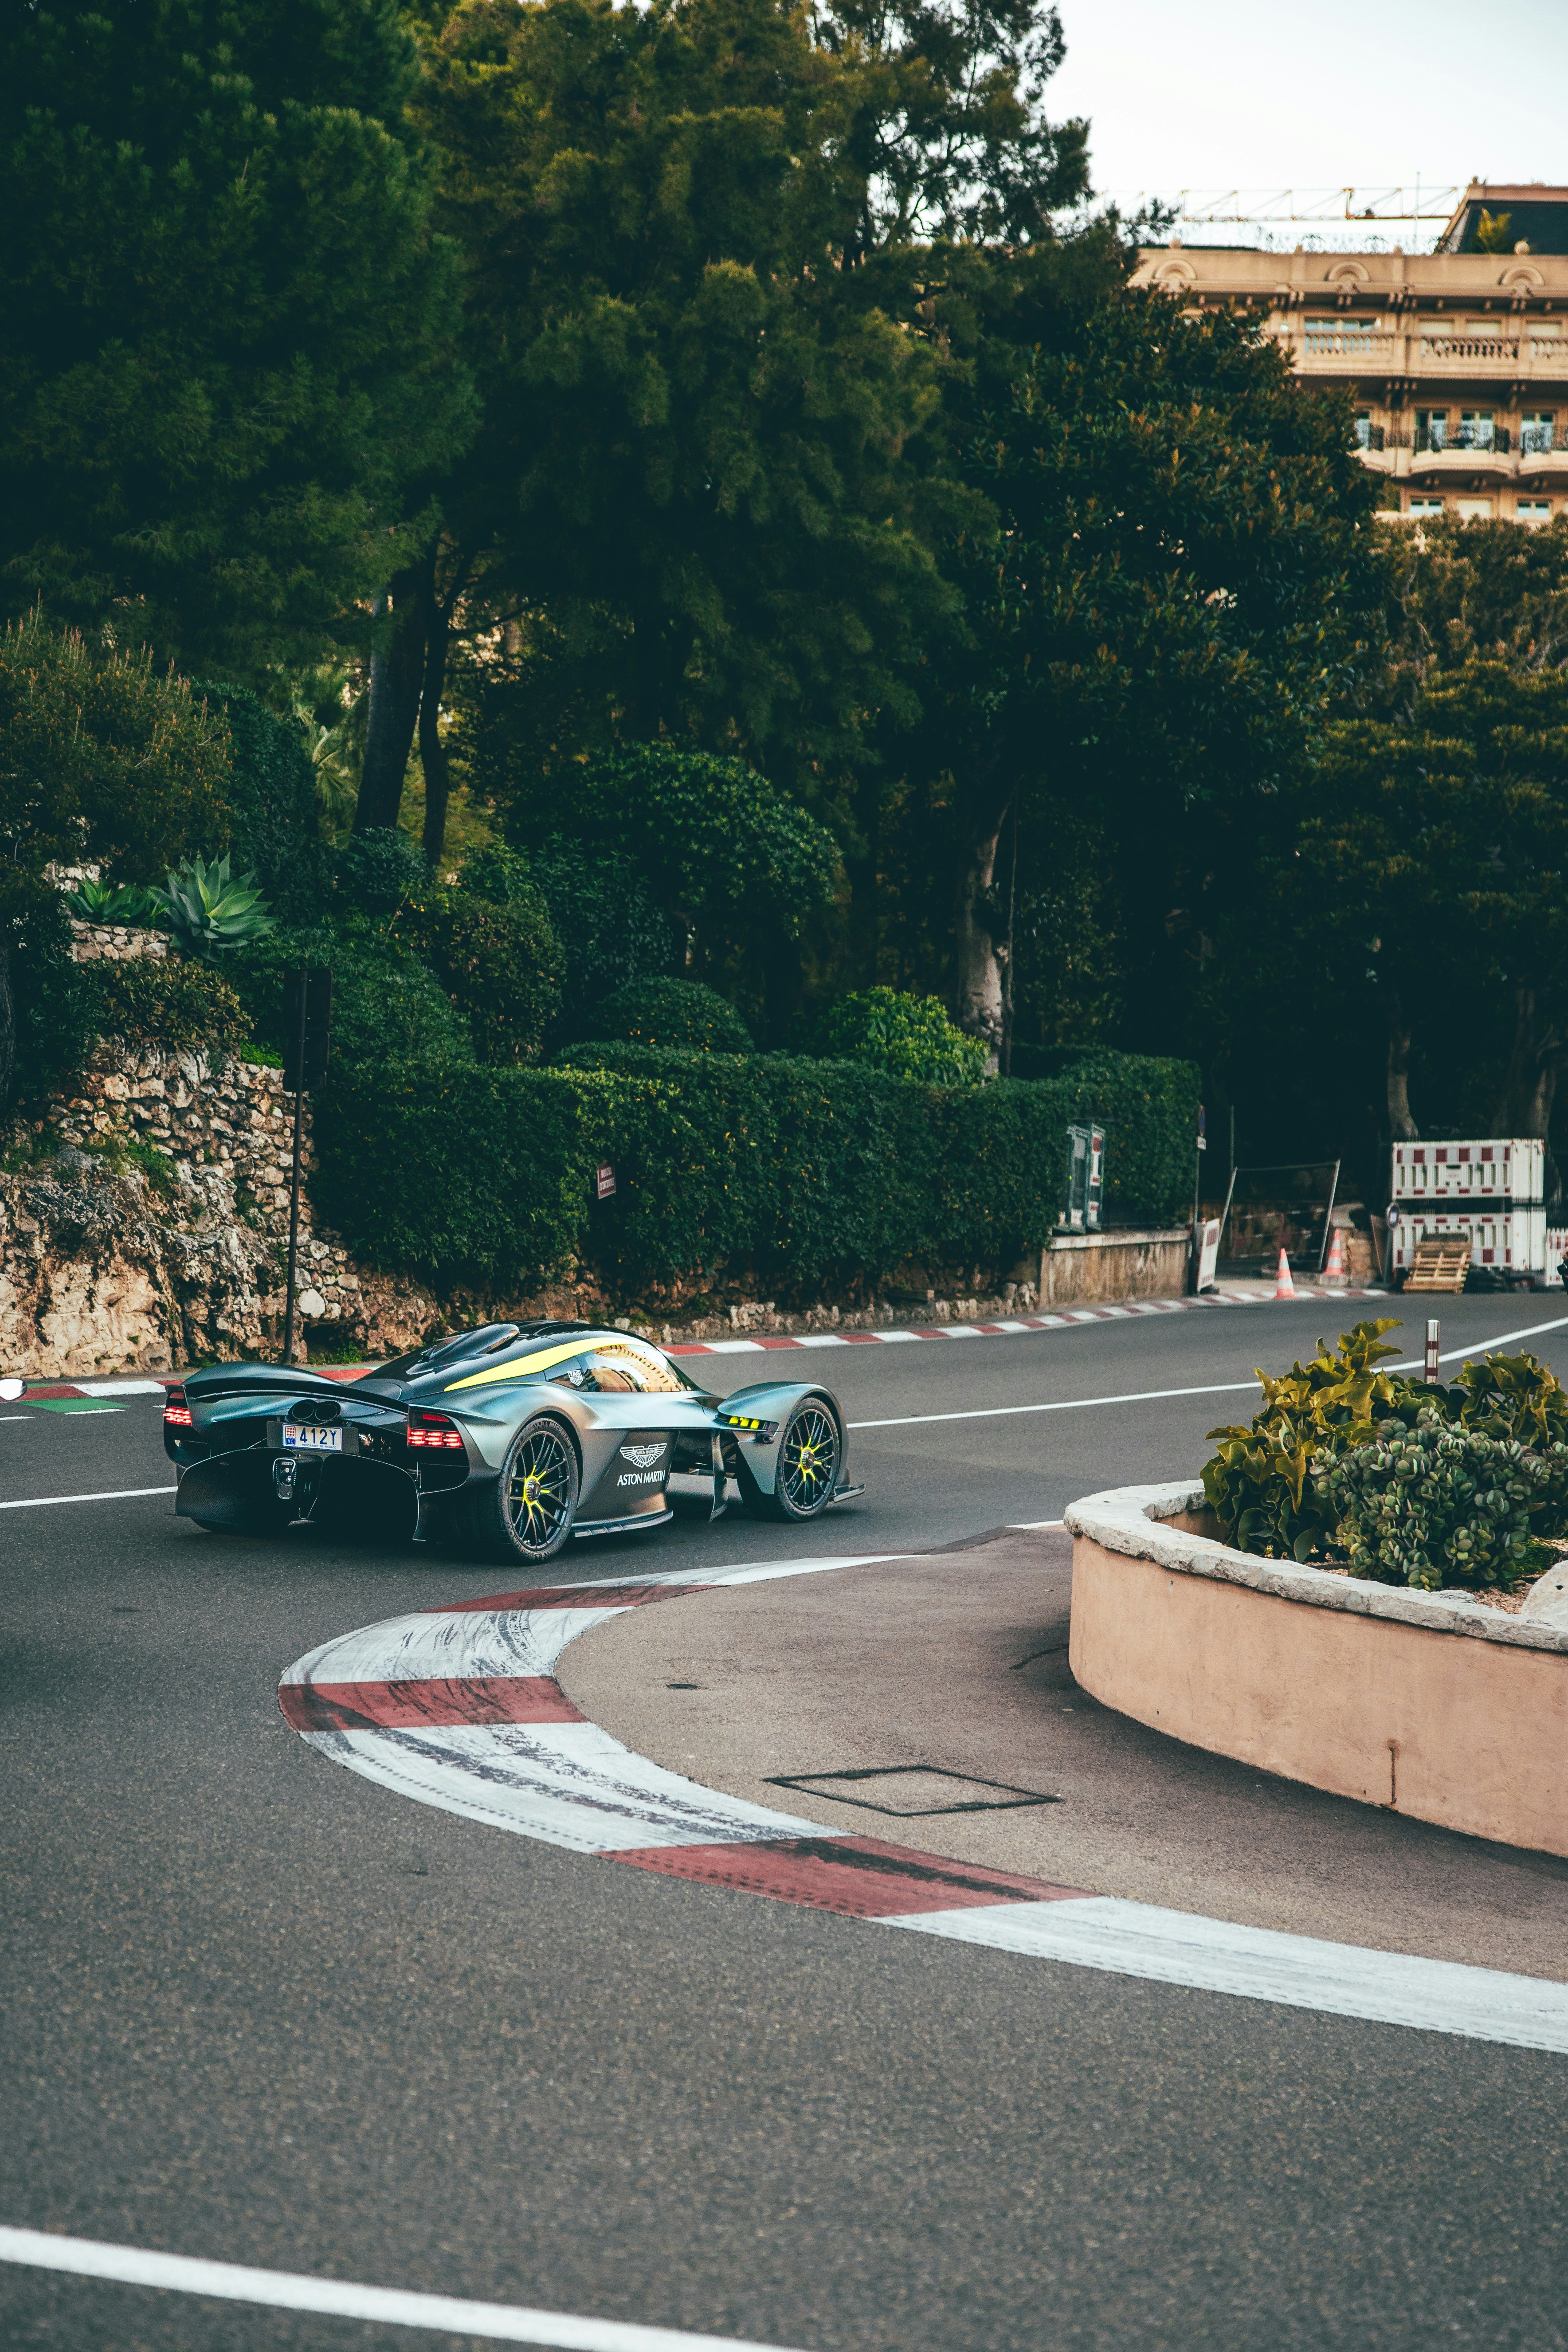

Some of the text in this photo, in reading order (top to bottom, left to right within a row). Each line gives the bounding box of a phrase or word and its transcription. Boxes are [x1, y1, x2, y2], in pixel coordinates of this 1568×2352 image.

[300, 1427, 337, 1446] 412Y
[617, 1470, 666, 1486] ASTON MARTIN
